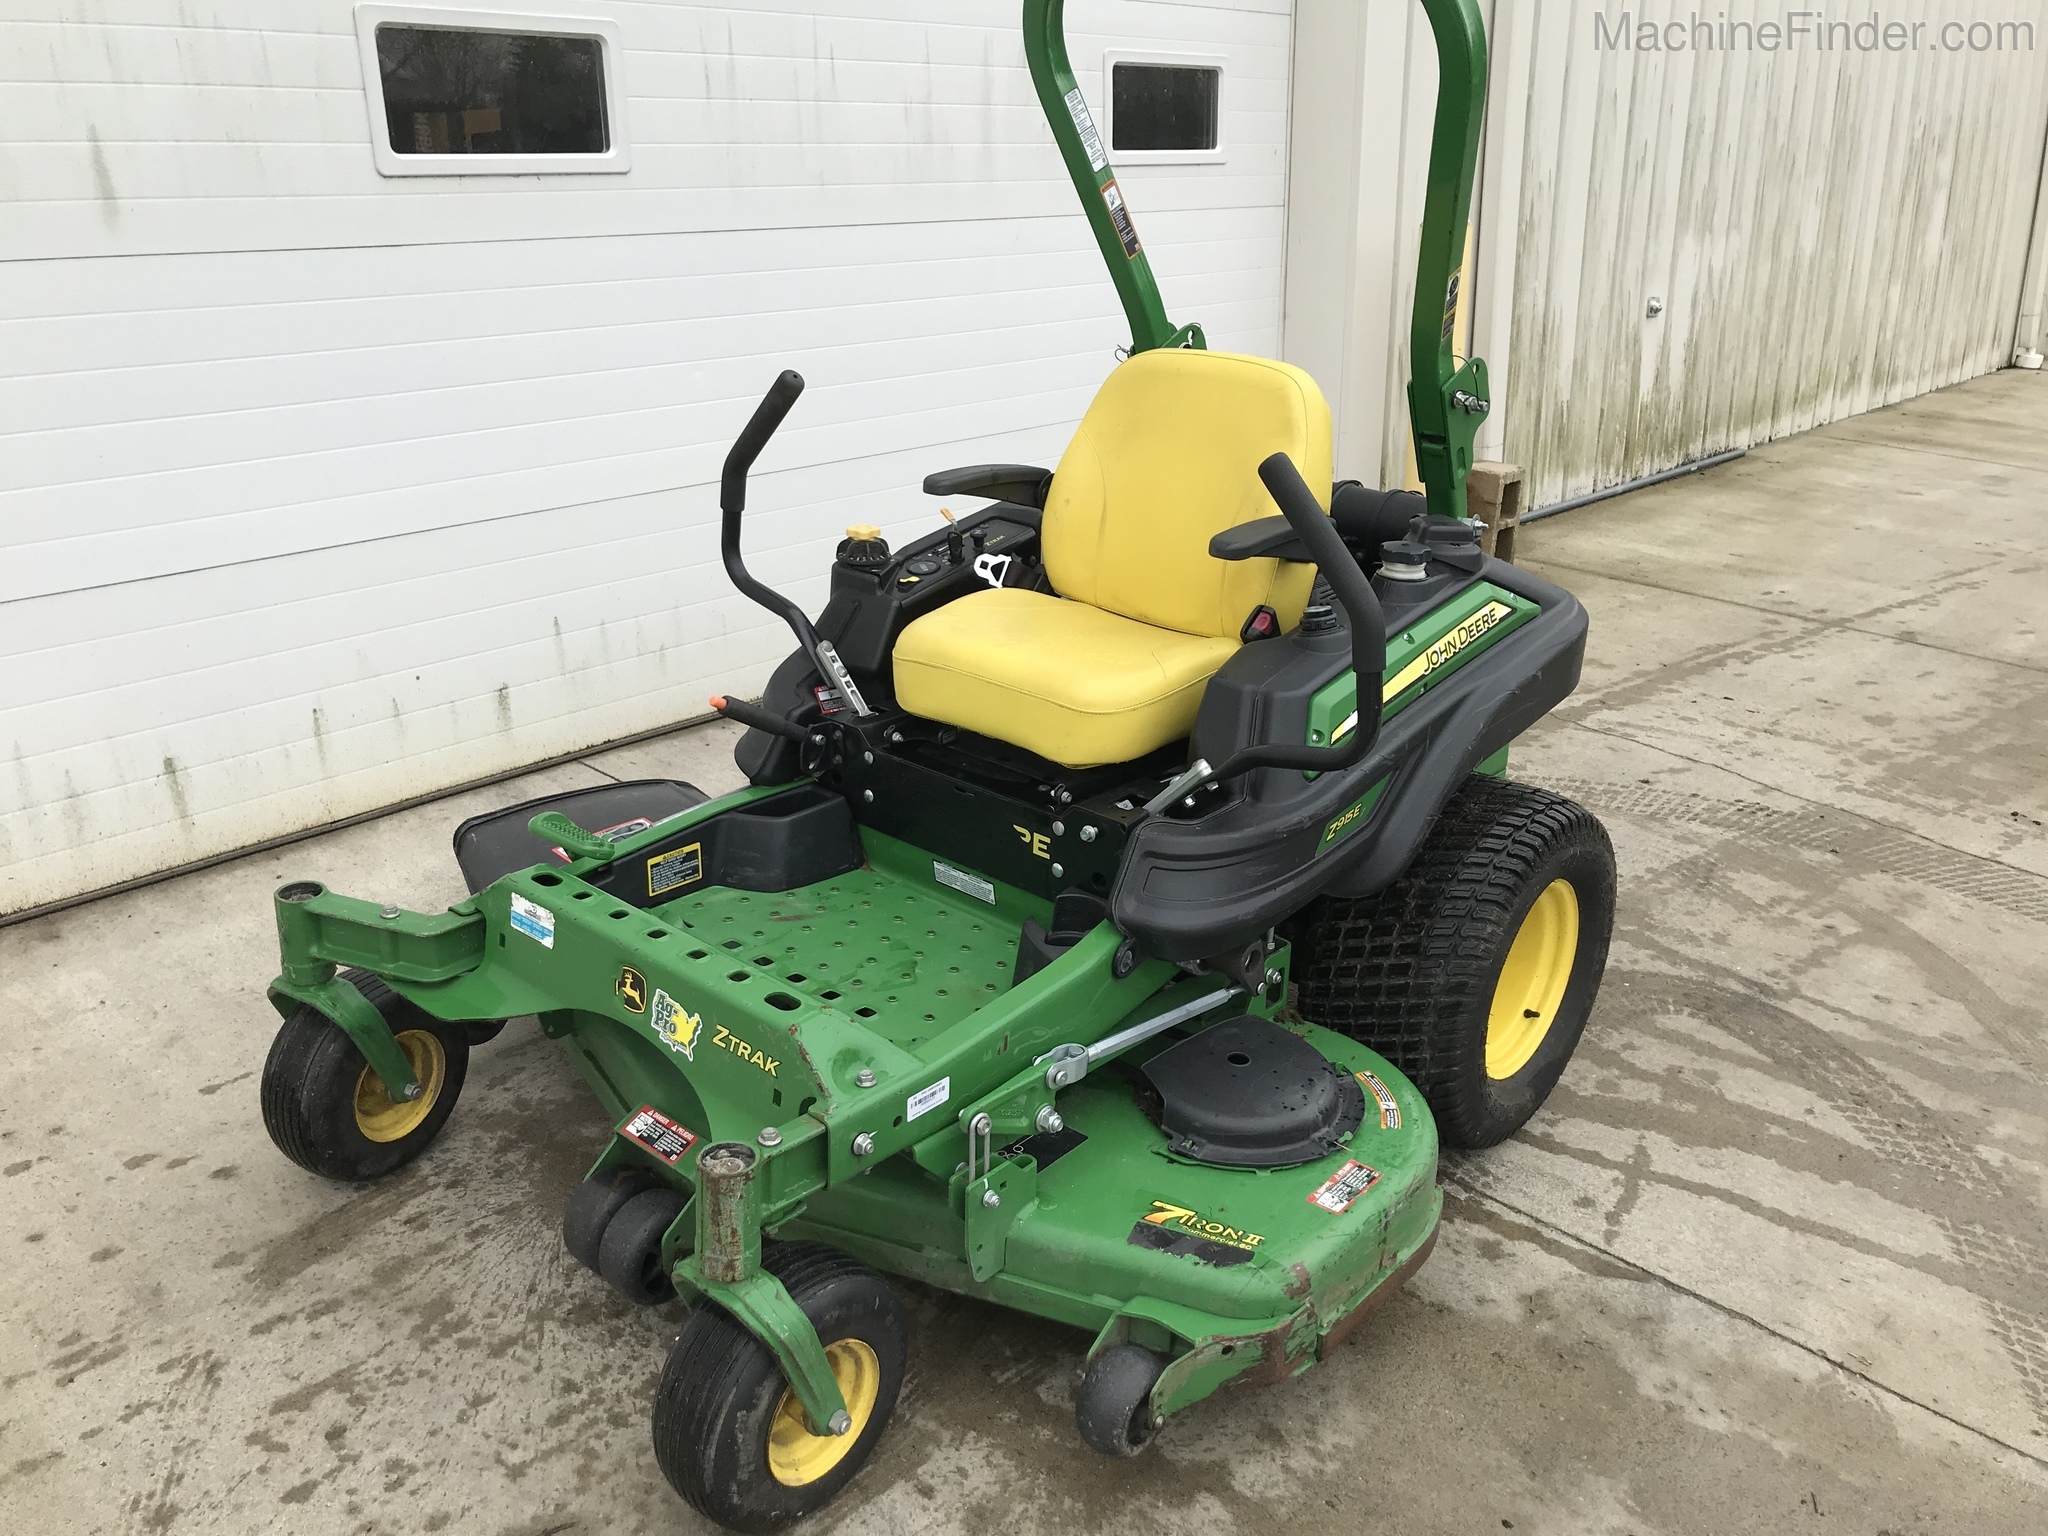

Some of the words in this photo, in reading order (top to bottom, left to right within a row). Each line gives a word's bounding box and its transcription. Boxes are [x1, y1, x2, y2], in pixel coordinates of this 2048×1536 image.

[1423, 635, 1457, 673] JOHN
[1457, 607, 1498, 646] DEERE
[1325, 803, 1362, 842] Z915E
[654, 1009, 677, 1034] Pro
[712, 1024, 782, 1078] ZTRAK
